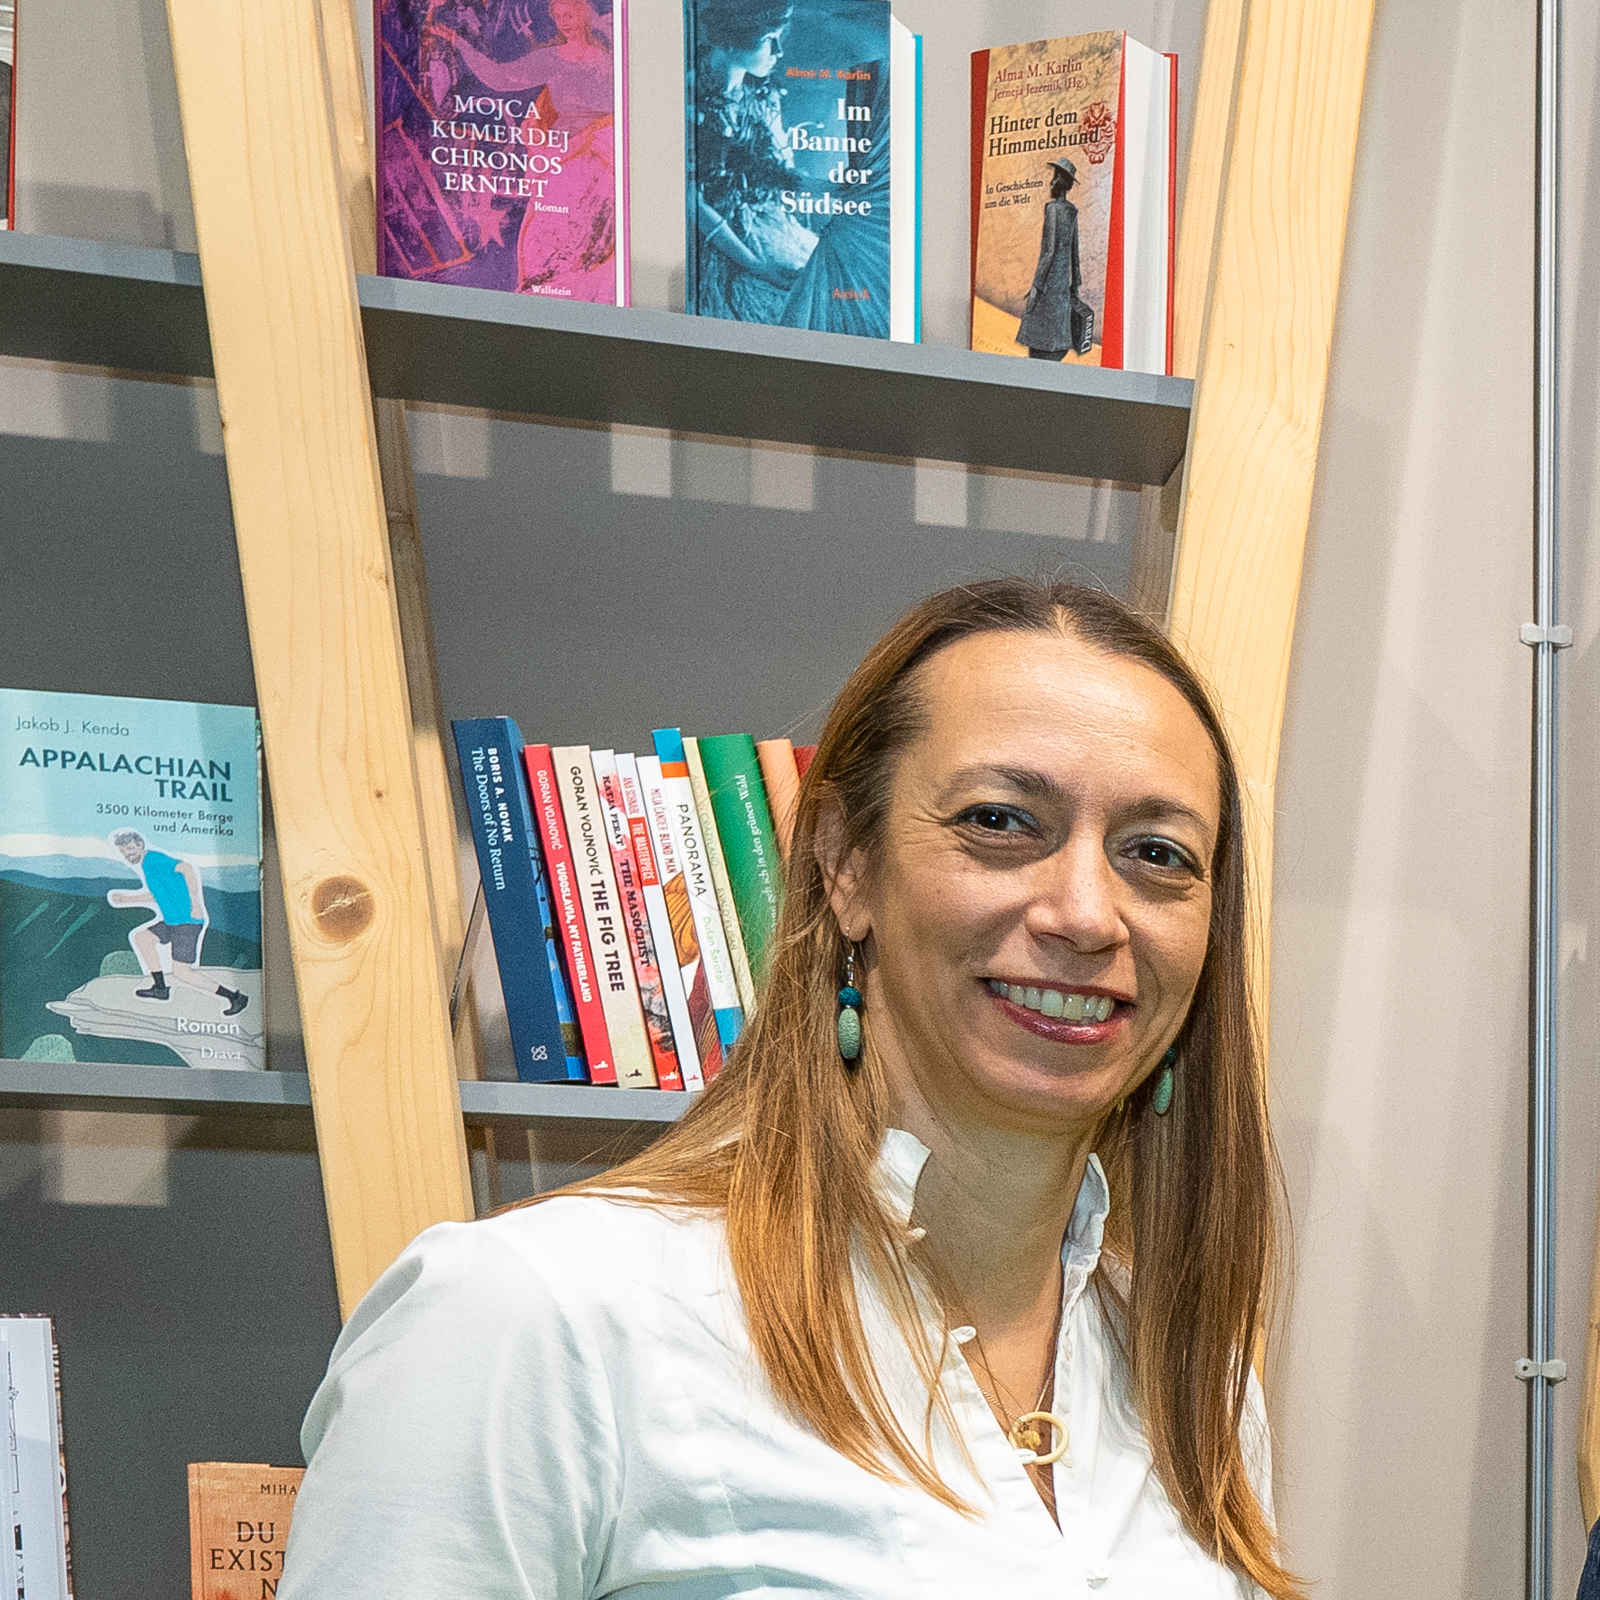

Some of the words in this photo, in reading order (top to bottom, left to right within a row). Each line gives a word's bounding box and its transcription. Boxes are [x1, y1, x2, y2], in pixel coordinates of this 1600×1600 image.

[994, 68, 1024, 84] Alma
[1027, 64, 1042, 79] M.
[1046, 58, 1082, 76] Karlin
[454, 95, 541, 121] MOJCA
[837, 98, 871, 121] Im
[989, 115, 1041, 135] Hinter
[1045, 107, 1077, 127] dem
[431, 120, 569, 153] KUMERDEJ
[790, 127, 872, 153] Banne
[988, 126, 1100, 157] Himmelshund
[431, 147, 562, 175] CHRONOS
[828, 162, 873, 184] der
[444, 172, 548, 198] ERNTET
[986, 184, 994, 195] In
[996, 179, 1043, 193] Geschichten
[534, 202, 569, 214] Roman
[781, 190, 872, 216] Südsee
[531, 284, 572, 296] Wallstein
[1081, 313, 1094, 352] Drava
[15, 716, 60, 732] Jakob
[63, 719, 75, 733] J.
[82, 721, 130, 737] Kenda
[19, 747, 231, 781] APPALACHIAN
[471, 746, 486, 771] The
[487, 747, 502, 783] BORIS
[154, 778, 234, 802] TRAIL
[475, 773, 493, 811] Doors
[494, 786, 505, 798] A.
[568, 765, 588, 811] GORAN
[96, 803, 130, 816] 3500
[134, 806, 194, 819] Kilometer
[198, 810, 234, 824] Berge
[483, 811, 496, 828] of
[497, 801, 513, 842] NOVAK
[153, 822, 177, 833] und
[181, 823, 234, 837] Amerika
[485, 828, 499, 846] No
[579, 814, 601, 876] VOJNOVIĆ
[676, 802, 707, 896] PANORAMA
[489, 847, 507, 890] Return
[589, 880, 608, 912] THE
[597, 915, 615, 946] FIG
[702, 916, 717, 946] Dušan
[603, 950, 625, 992] TREE
[709, 948, 726, 984] Šarotar
[177, 1017, 241, 1035] Roman
[200, 1047, 242, 1060] Drava
[260, 1484, 297, 1495] MIHA
[236, 1521, 275, 1544] DU
